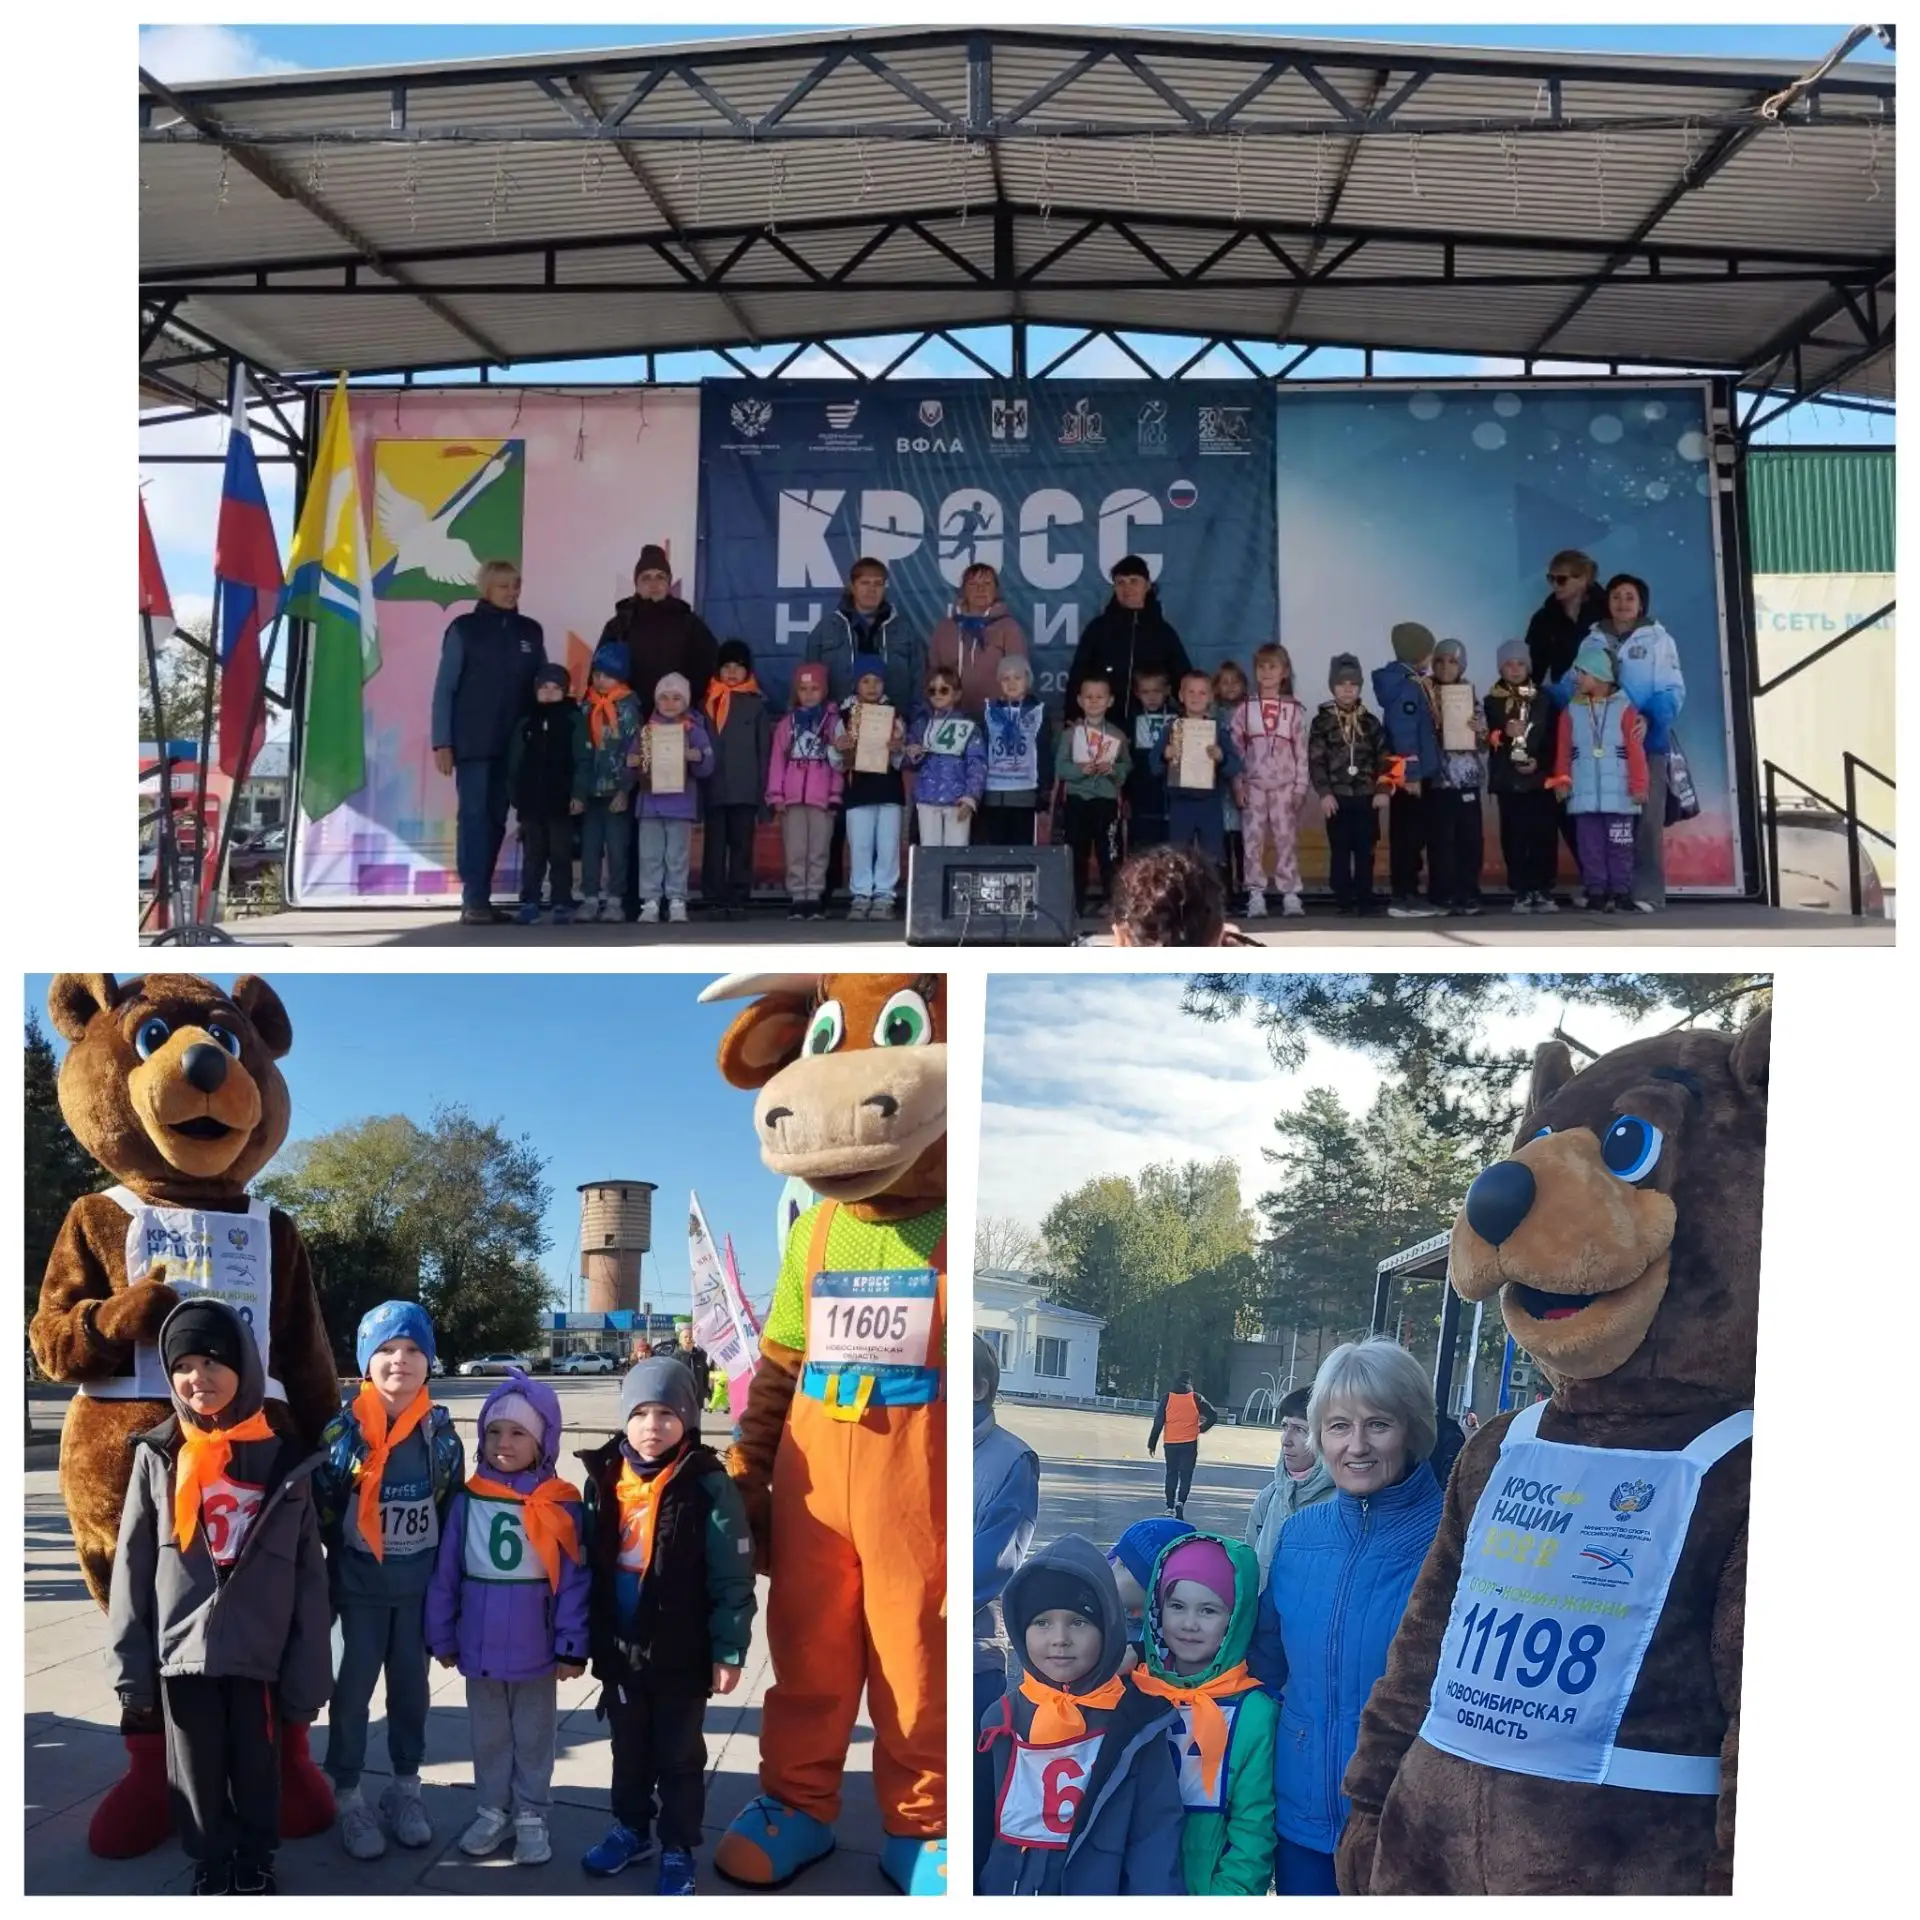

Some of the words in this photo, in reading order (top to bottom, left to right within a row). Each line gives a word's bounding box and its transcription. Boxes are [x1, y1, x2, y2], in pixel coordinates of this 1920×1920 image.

[896, 437, 964, 453] ВФЛА
[777, 488, 1163, 589] КРОСС
[1772, 612, 1837, 631] СЕТЬ
[936, 722, 957, 751] 4
[958, 723, 968, 738] 3
[853, 1275, 891, 1288] КРОСС
[827, 1304, 909, 1341] 11605
[1501, 1476, 1562, 1507] КРОСС
[378, 1505, 430, 1536] 1785
[1491, 1499, 1574, 1534] НАЦИИ
[488, 1511, 523, 1572] 6
[1455, 1603, 1606, 1695] 11198
[1446, 1679, 1577, 1725] НОВОСИБИРСКАЯ
[1456, 1708, 1529, 1740] ОБЛАСТЬ
[1041, 1757, 1086, 1834] 6
